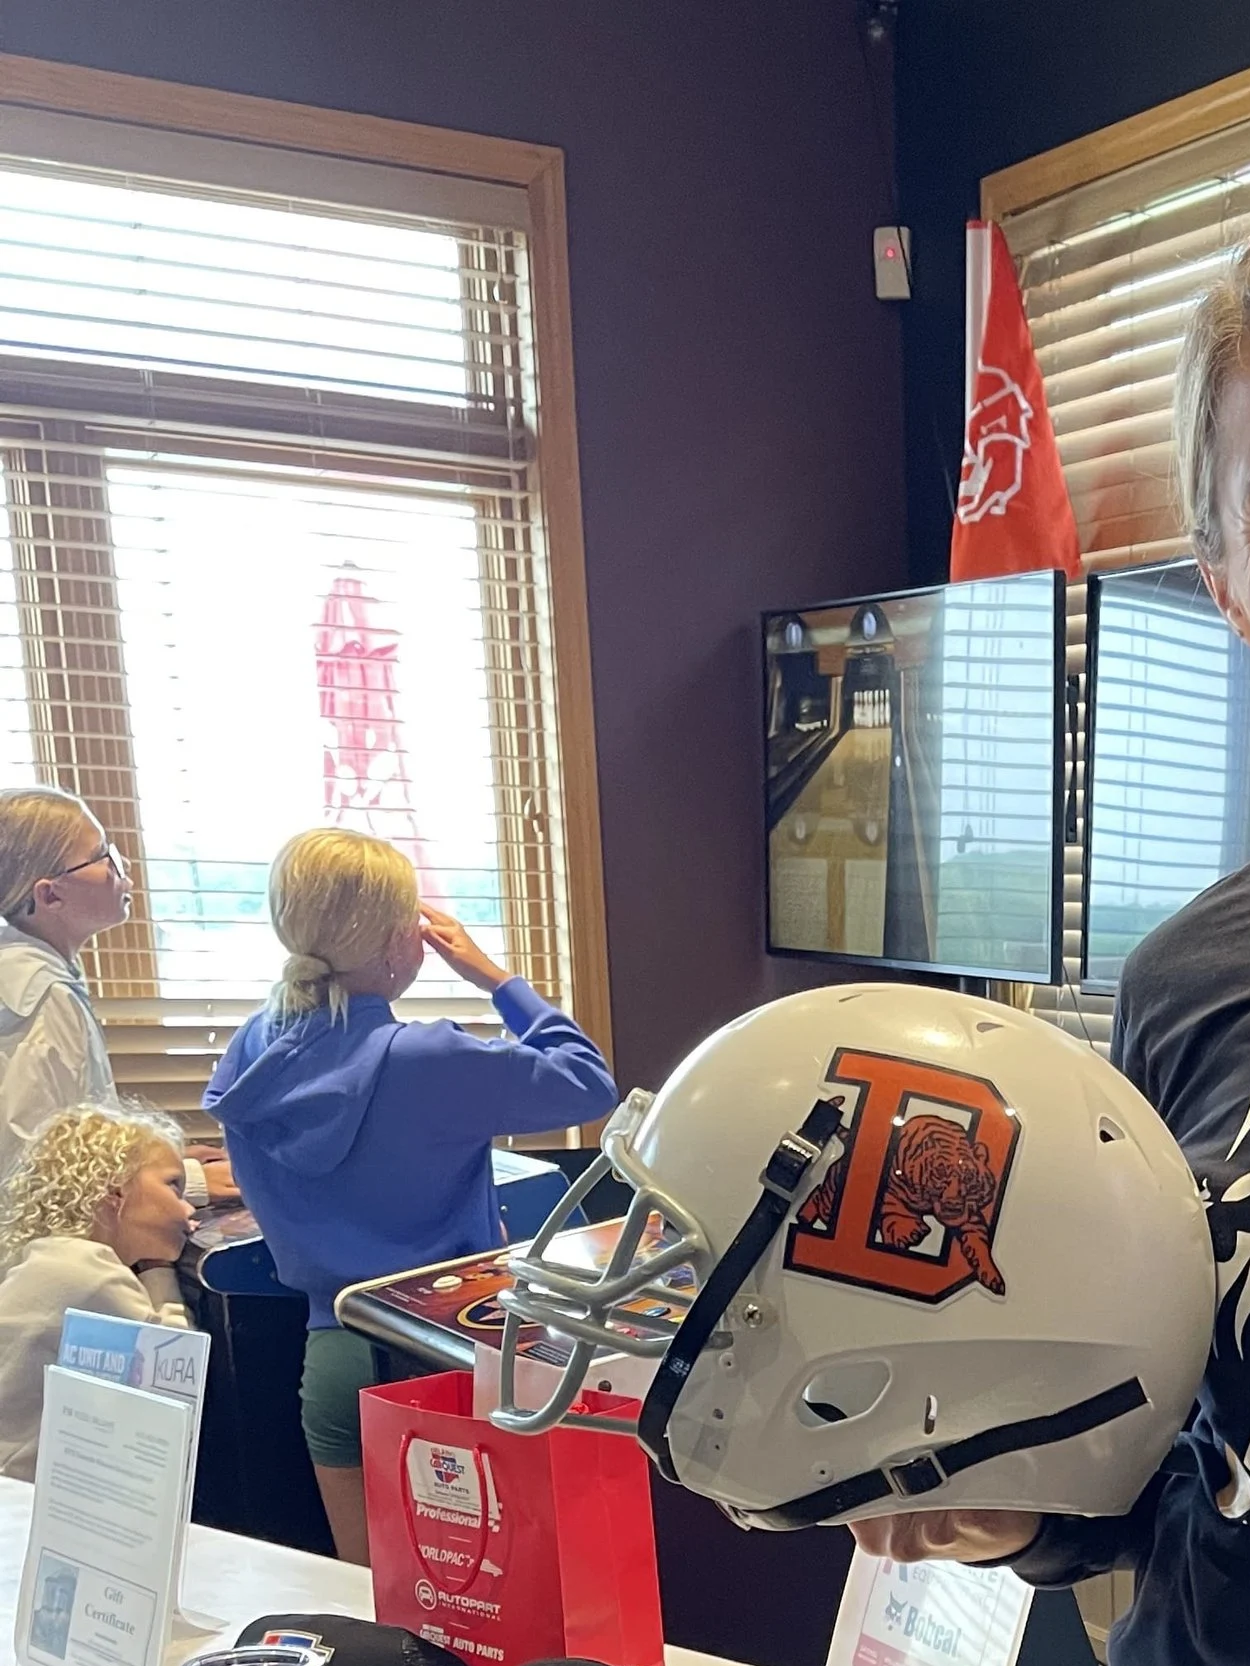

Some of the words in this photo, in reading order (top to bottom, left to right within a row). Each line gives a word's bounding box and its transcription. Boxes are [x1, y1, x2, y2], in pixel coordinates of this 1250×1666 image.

[783, 1047, 1021, 1304] D
[62, 1343, 76, 1365] AC
[78, 1346, 101, 1368] UNIT
[103, 1351, 126, 1373] AND
[416, 1503, 481, 1529] Professional
[104, 1586, 124, 1605] Gift
[438, 1591, 501, 1614] AUTOPART
[84, 1602, 136, 1636] Certificate
[903, 1606, 962, 1658] Bobcat
[452, 1636, 475, 1654] AUTO
[476, 1643, 504, 1662] PARTS
